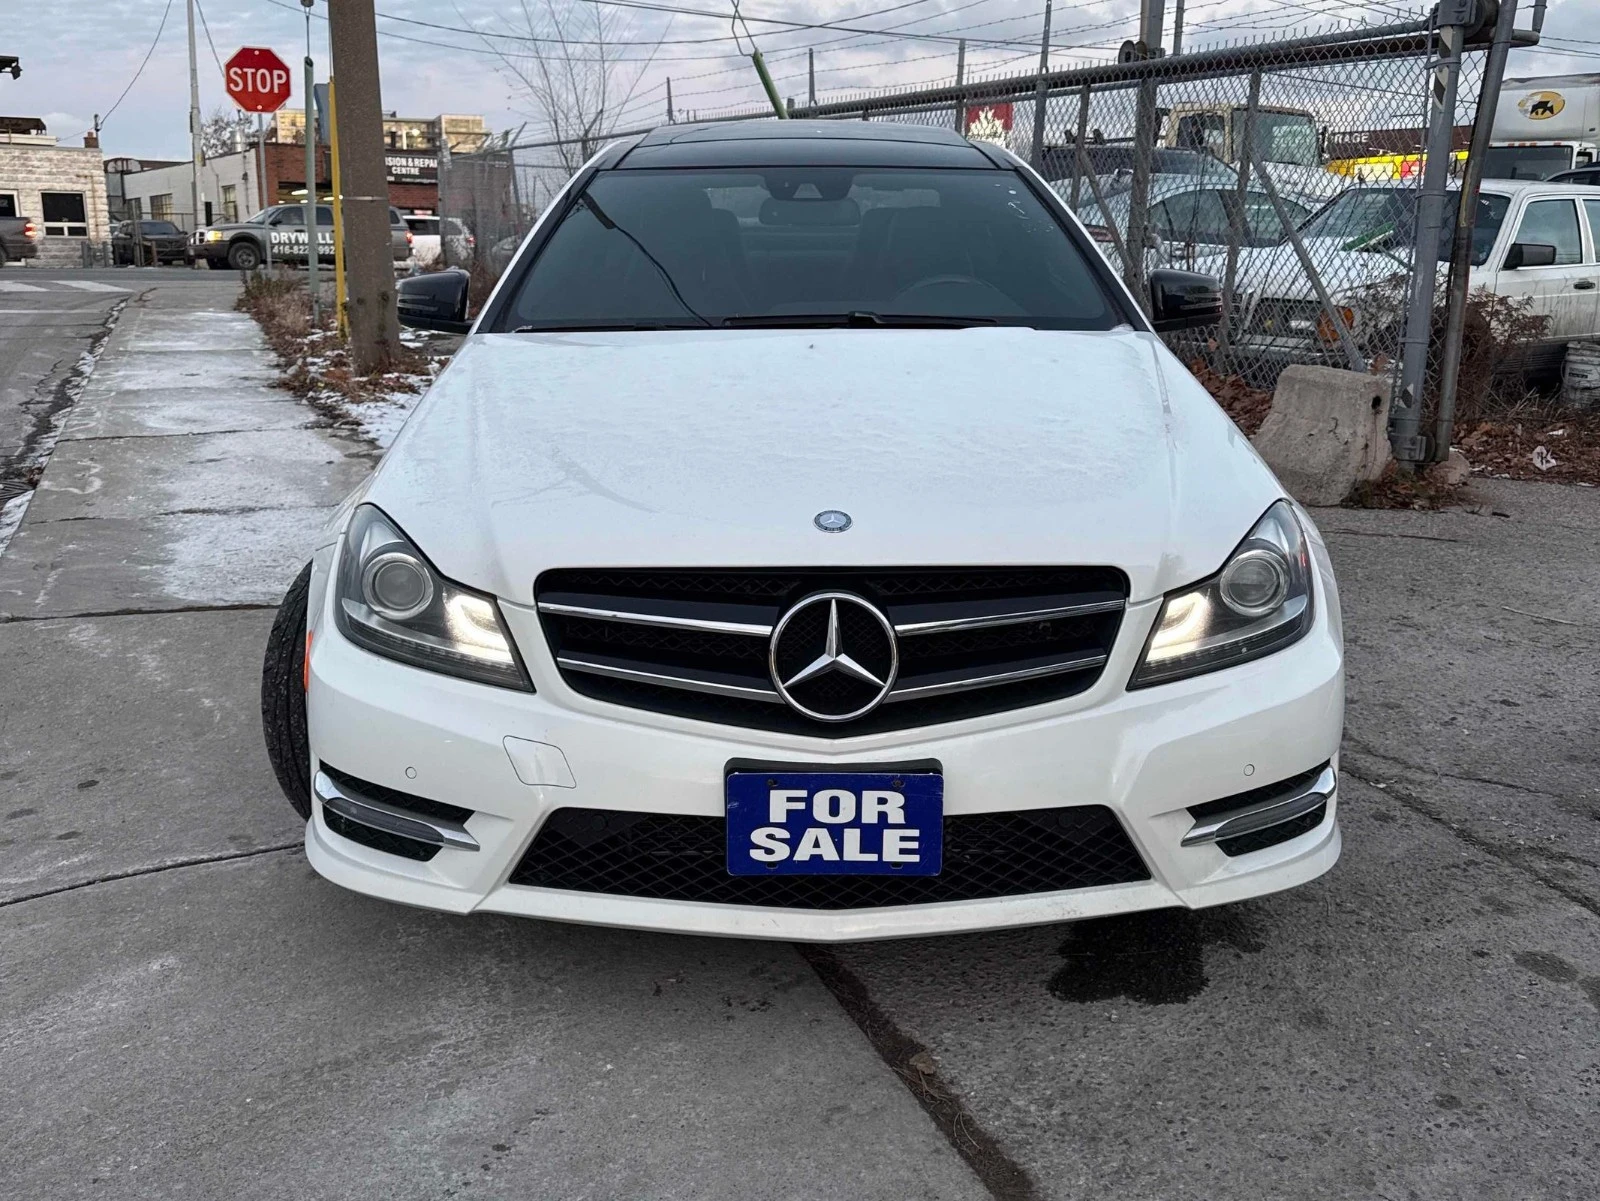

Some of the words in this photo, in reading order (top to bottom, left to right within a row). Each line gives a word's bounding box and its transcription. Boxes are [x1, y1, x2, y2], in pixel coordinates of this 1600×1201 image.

[229, 67, 287, 94] STOP
[391, 166, 420, 175] CENTRE
[407, 157, 413, 167] &
[270, 232, 334, 244] DRYWLL
[769, 789, 906, 825] FOR
[749, 826, 921, 863] SALE
